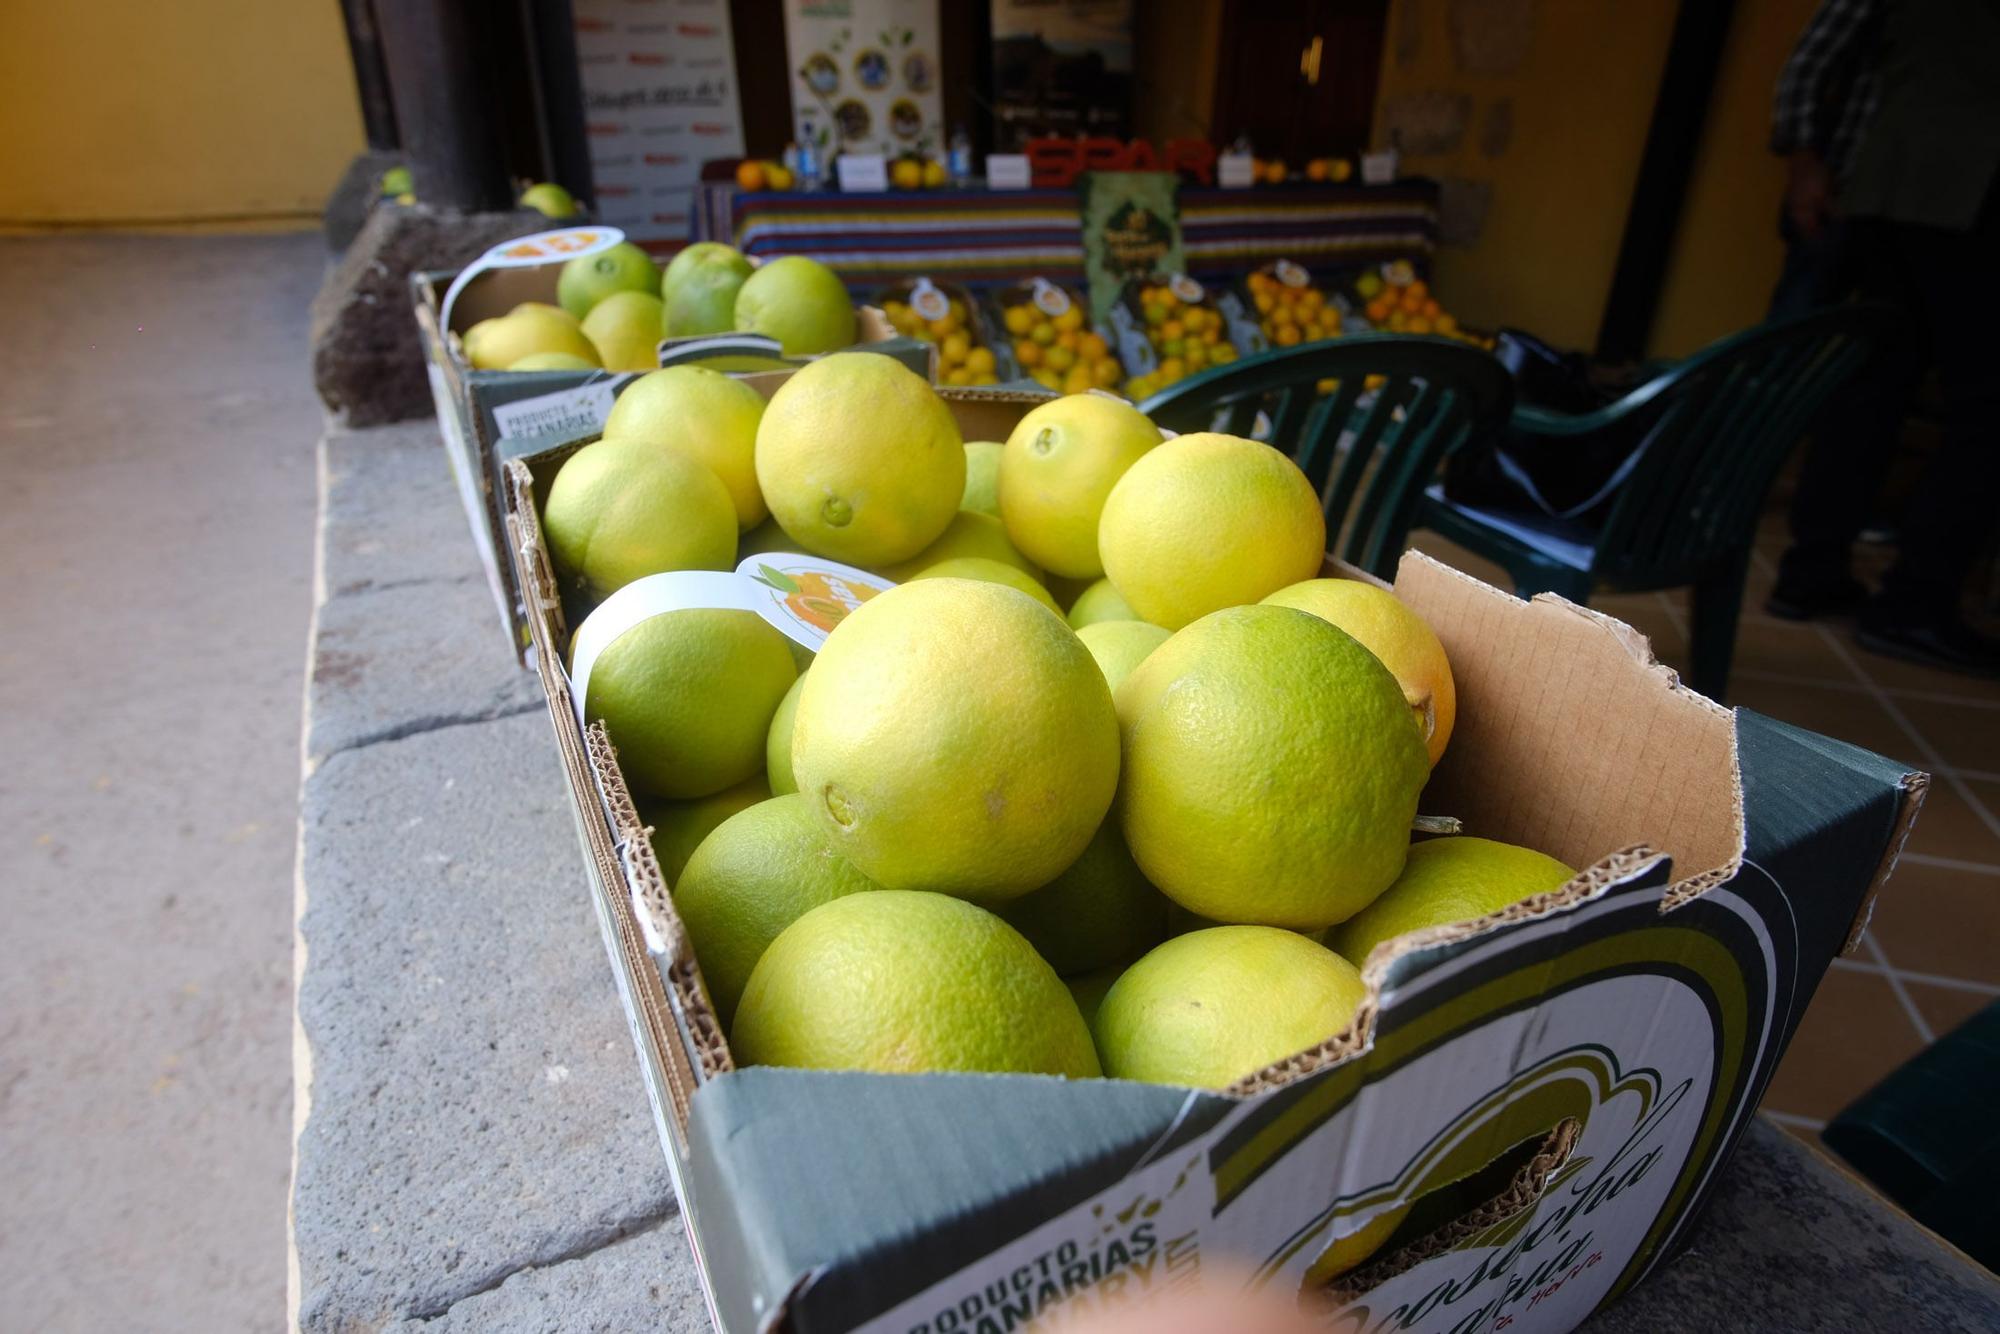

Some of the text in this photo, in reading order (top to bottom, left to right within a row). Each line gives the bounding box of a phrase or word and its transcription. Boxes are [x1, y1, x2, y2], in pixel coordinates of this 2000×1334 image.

[1024, 136, 1214, 189] SPAR
[907, 1239, 1079, 1334] ODUCTO
[955, 1223, 1157, 1334] ANARIAS
